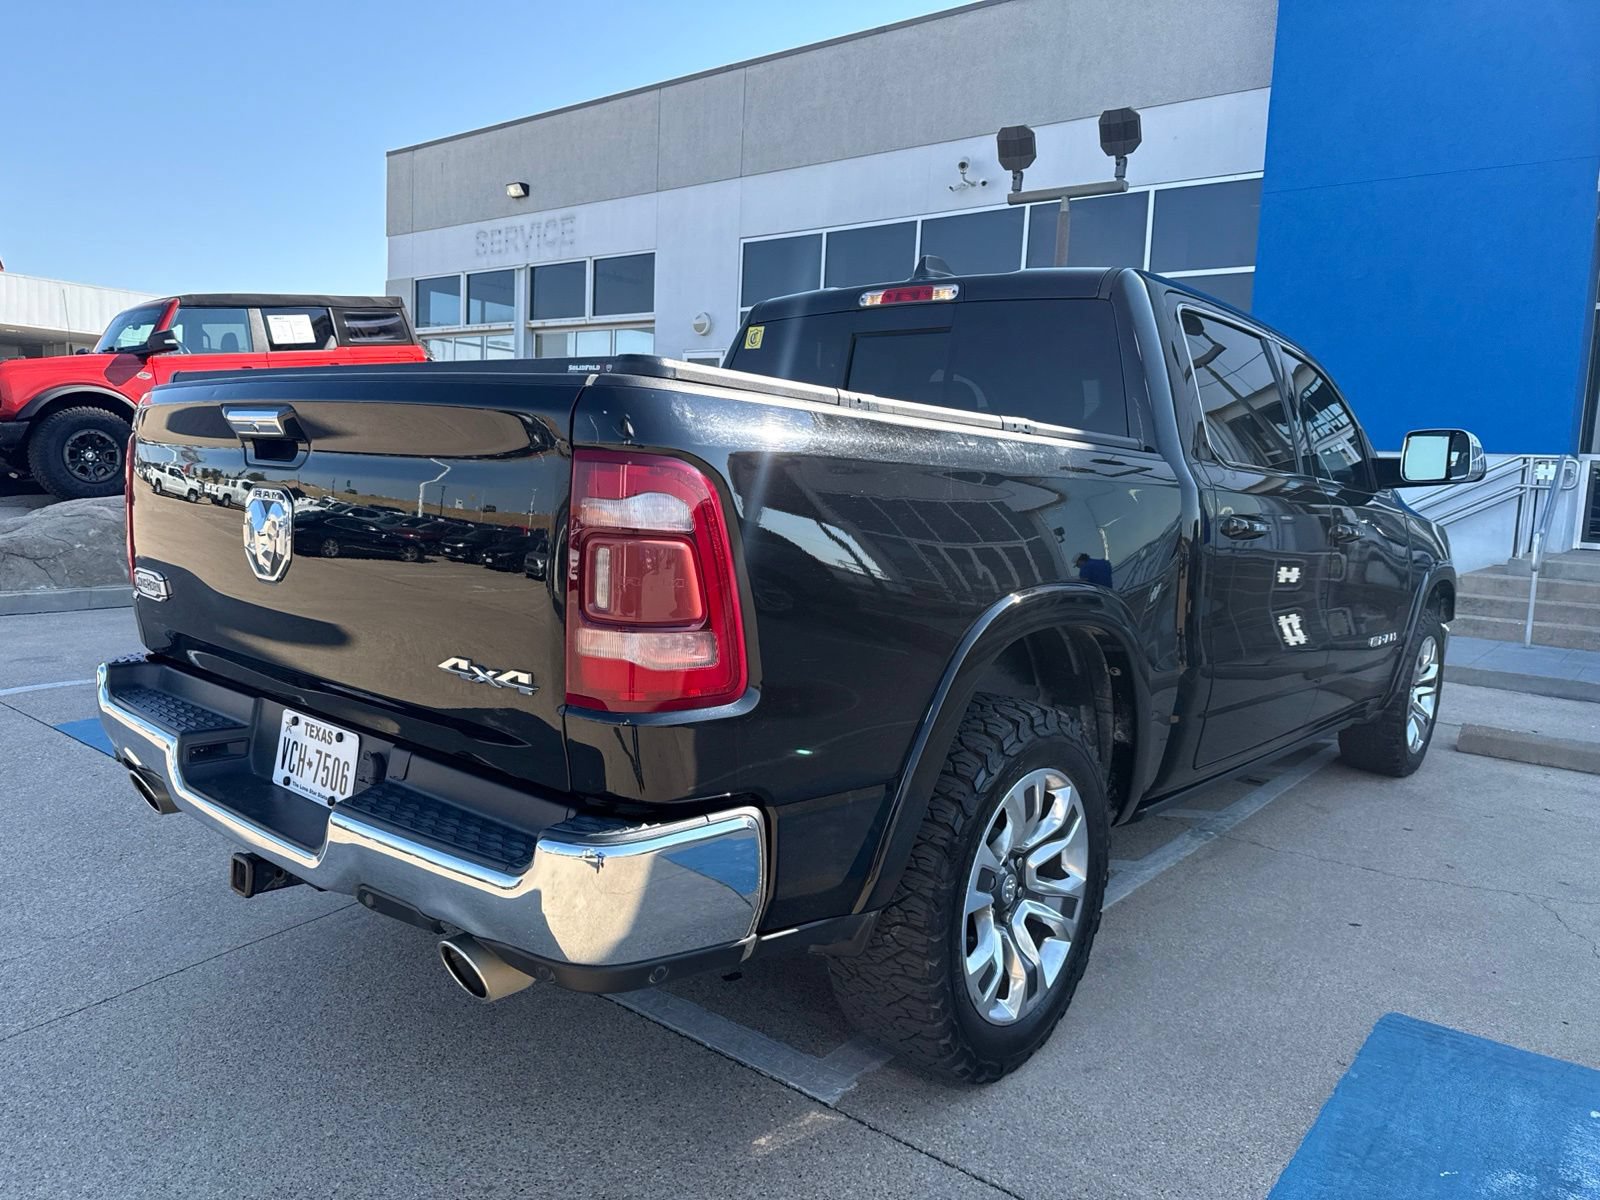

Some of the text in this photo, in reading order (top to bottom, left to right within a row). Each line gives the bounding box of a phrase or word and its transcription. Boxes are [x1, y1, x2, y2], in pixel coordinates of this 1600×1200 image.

[475, 216, 576, 256] SERVICE
[254, 490, 281, 499] RAM
[304, 721, 334, 746] TEXAS
